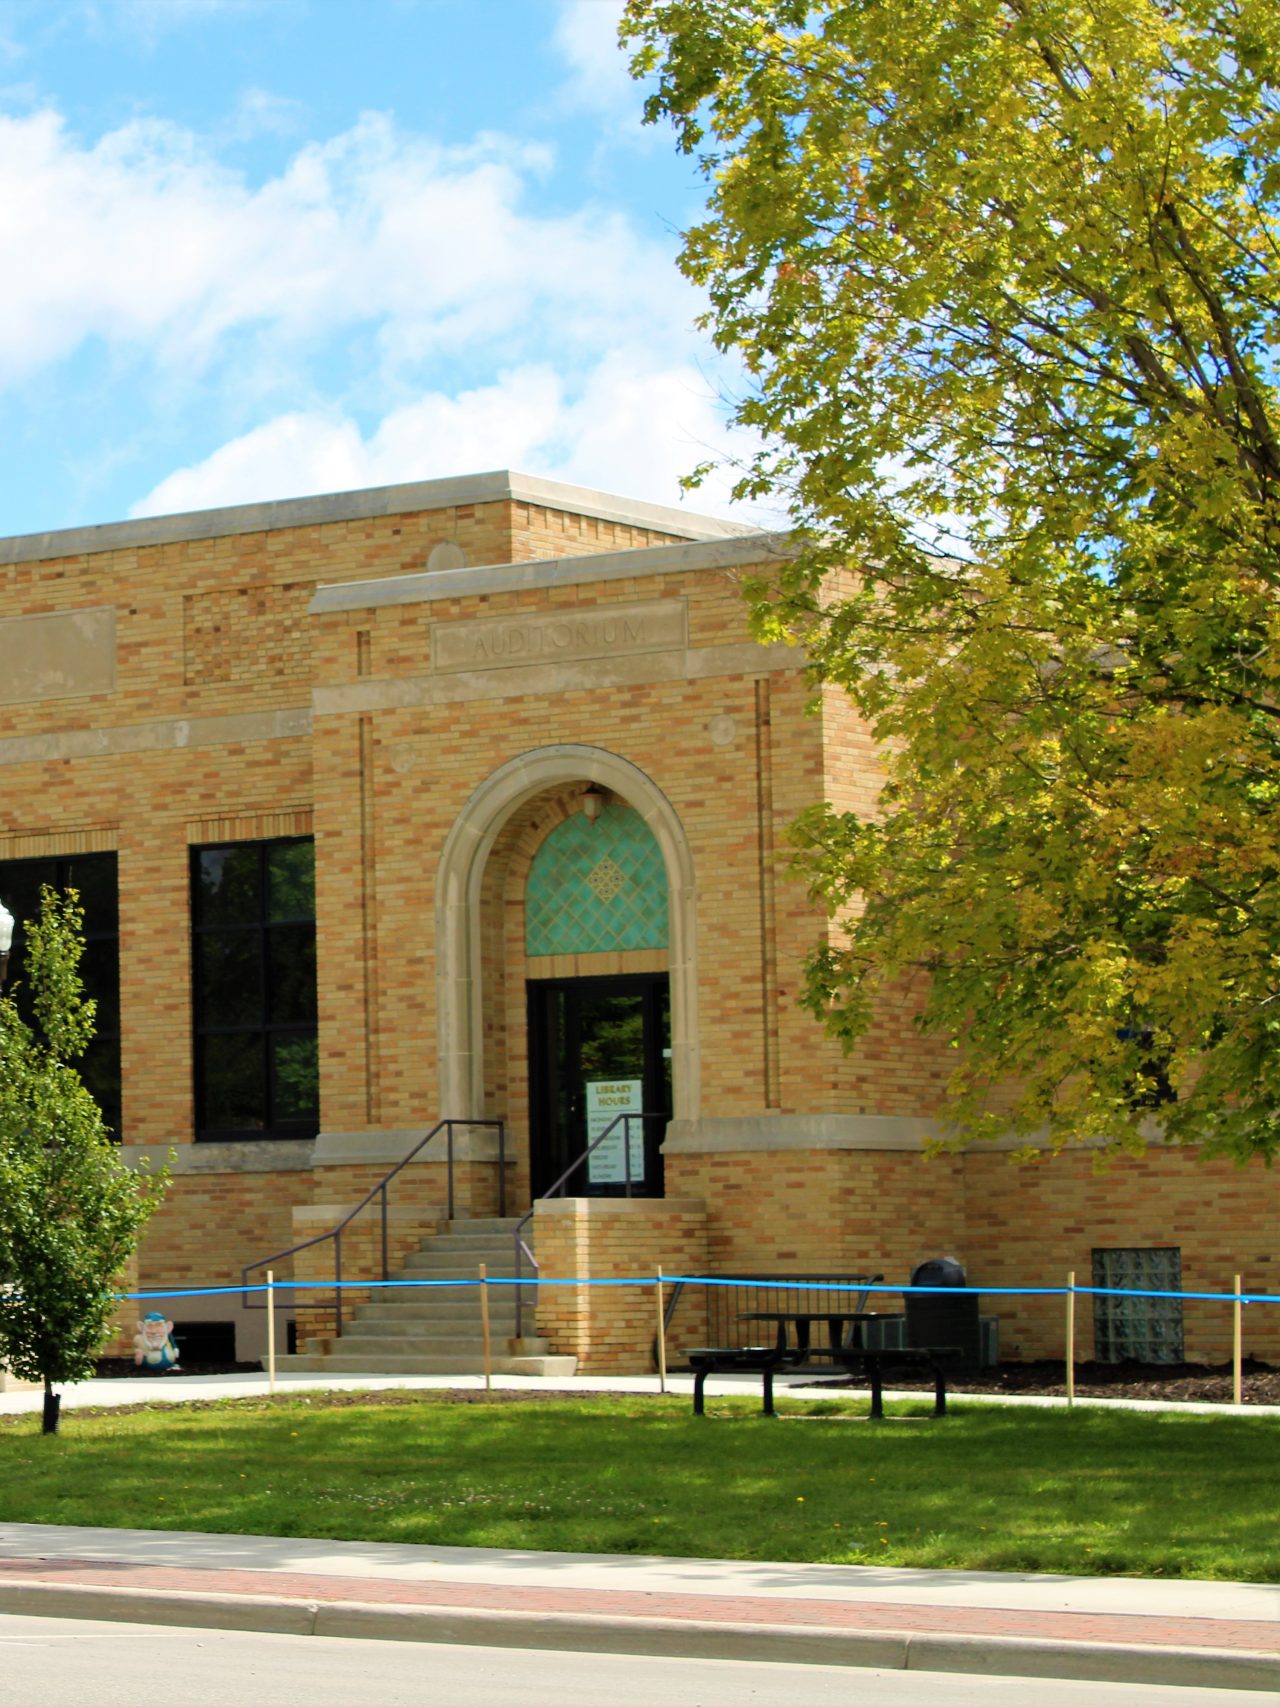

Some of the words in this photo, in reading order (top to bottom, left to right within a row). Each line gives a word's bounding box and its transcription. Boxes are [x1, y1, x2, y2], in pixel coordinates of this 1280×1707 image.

[471, 618, 646, 658] AUDITORIUM
[595, 1084, 632, 1095] LIBRARY
[598, 1096, 631, 1106] HOURS
